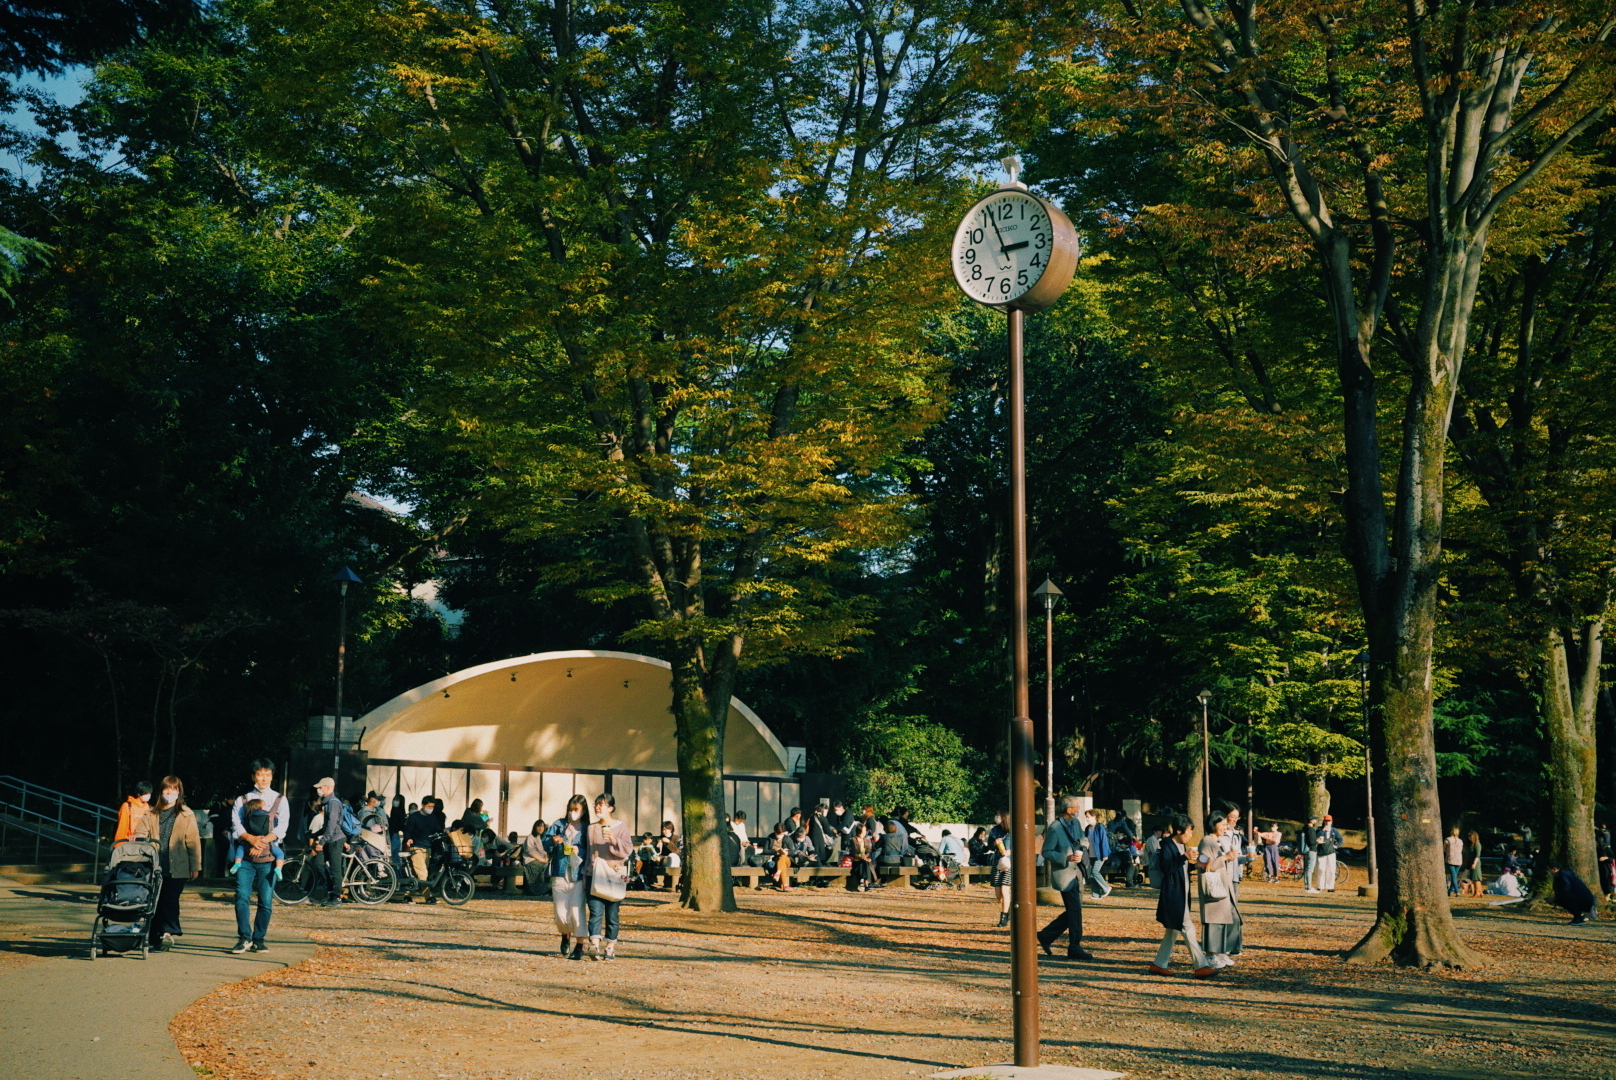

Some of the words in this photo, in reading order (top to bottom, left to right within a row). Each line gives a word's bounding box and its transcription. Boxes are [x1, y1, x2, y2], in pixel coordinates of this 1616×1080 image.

[984, 211, 994, 228] 11
[998, 204, 1013, 221] 12
[1030, 214, 1040, 231] 2
[970, 228, 984, 245] 10
[1035, 233, 1046, 249] 3
[965, 248, 976, 264] 9
[1030, 252, 1041, 268] 4
[972, 264, 982, 280] 8
[1018, 269, 1028, 285] 5
[985, 276, 995, 292] 7
[1000, 278, 1011, 294] 6
